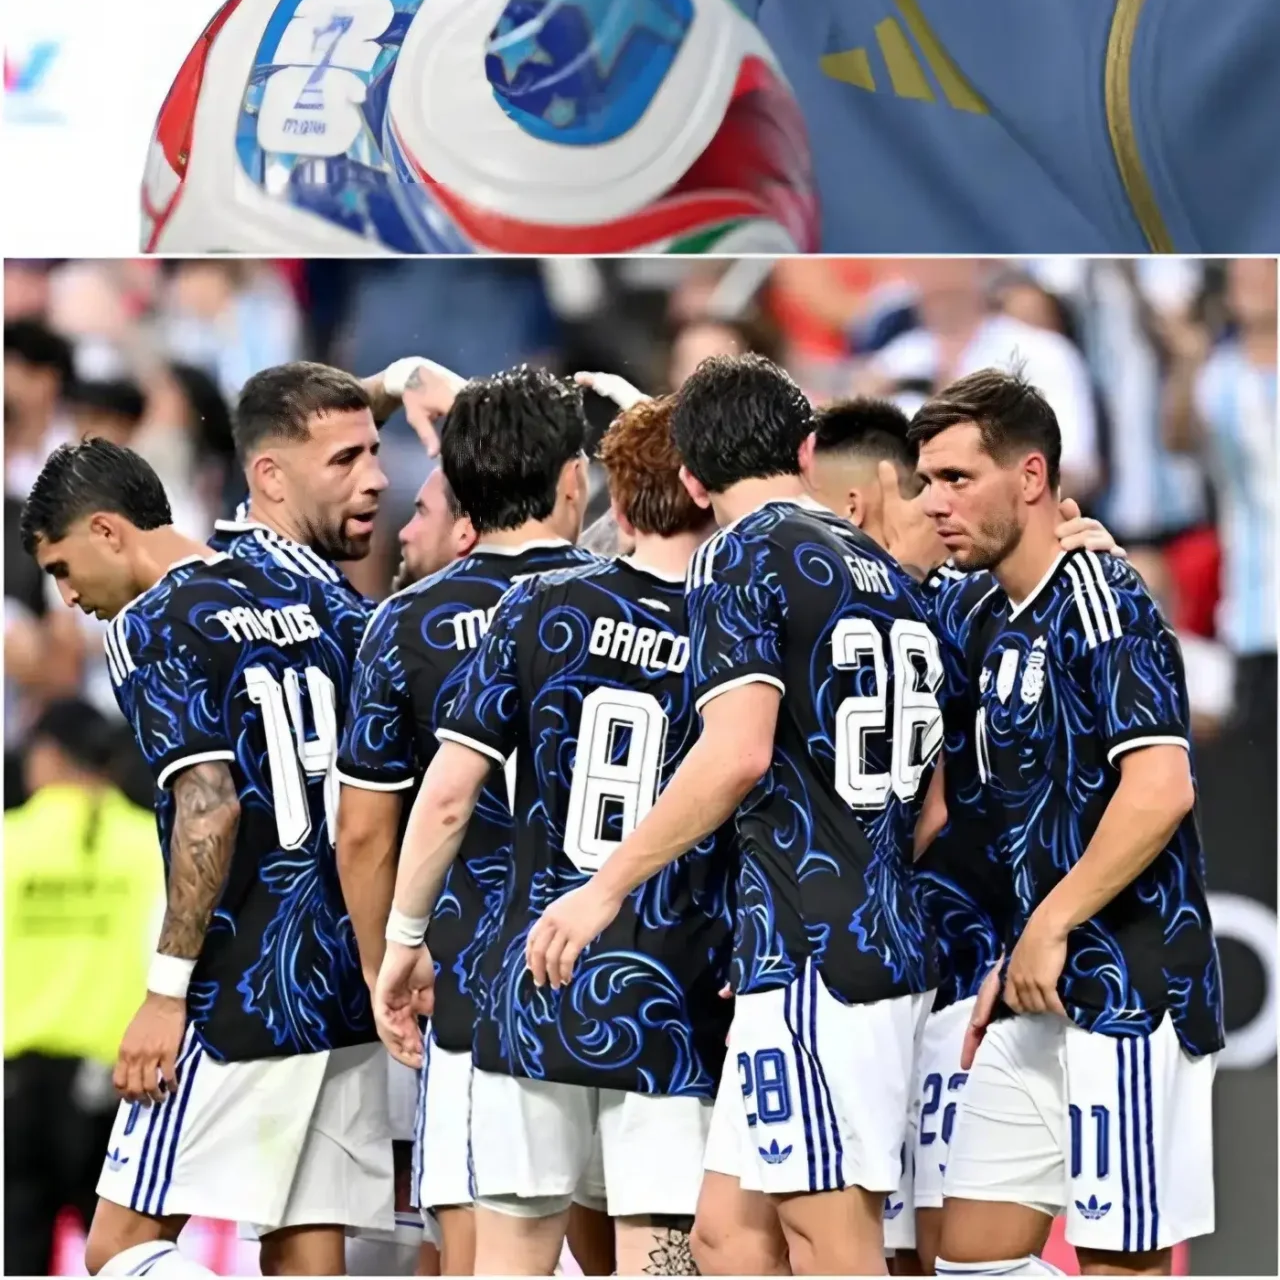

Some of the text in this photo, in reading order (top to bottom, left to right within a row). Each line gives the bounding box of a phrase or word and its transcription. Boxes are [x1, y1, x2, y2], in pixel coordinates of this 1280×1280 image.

[588, 616, 691, 673] BARCO
[243, 665, 341, 851] 14
[563, 685, 670, 877] 8
